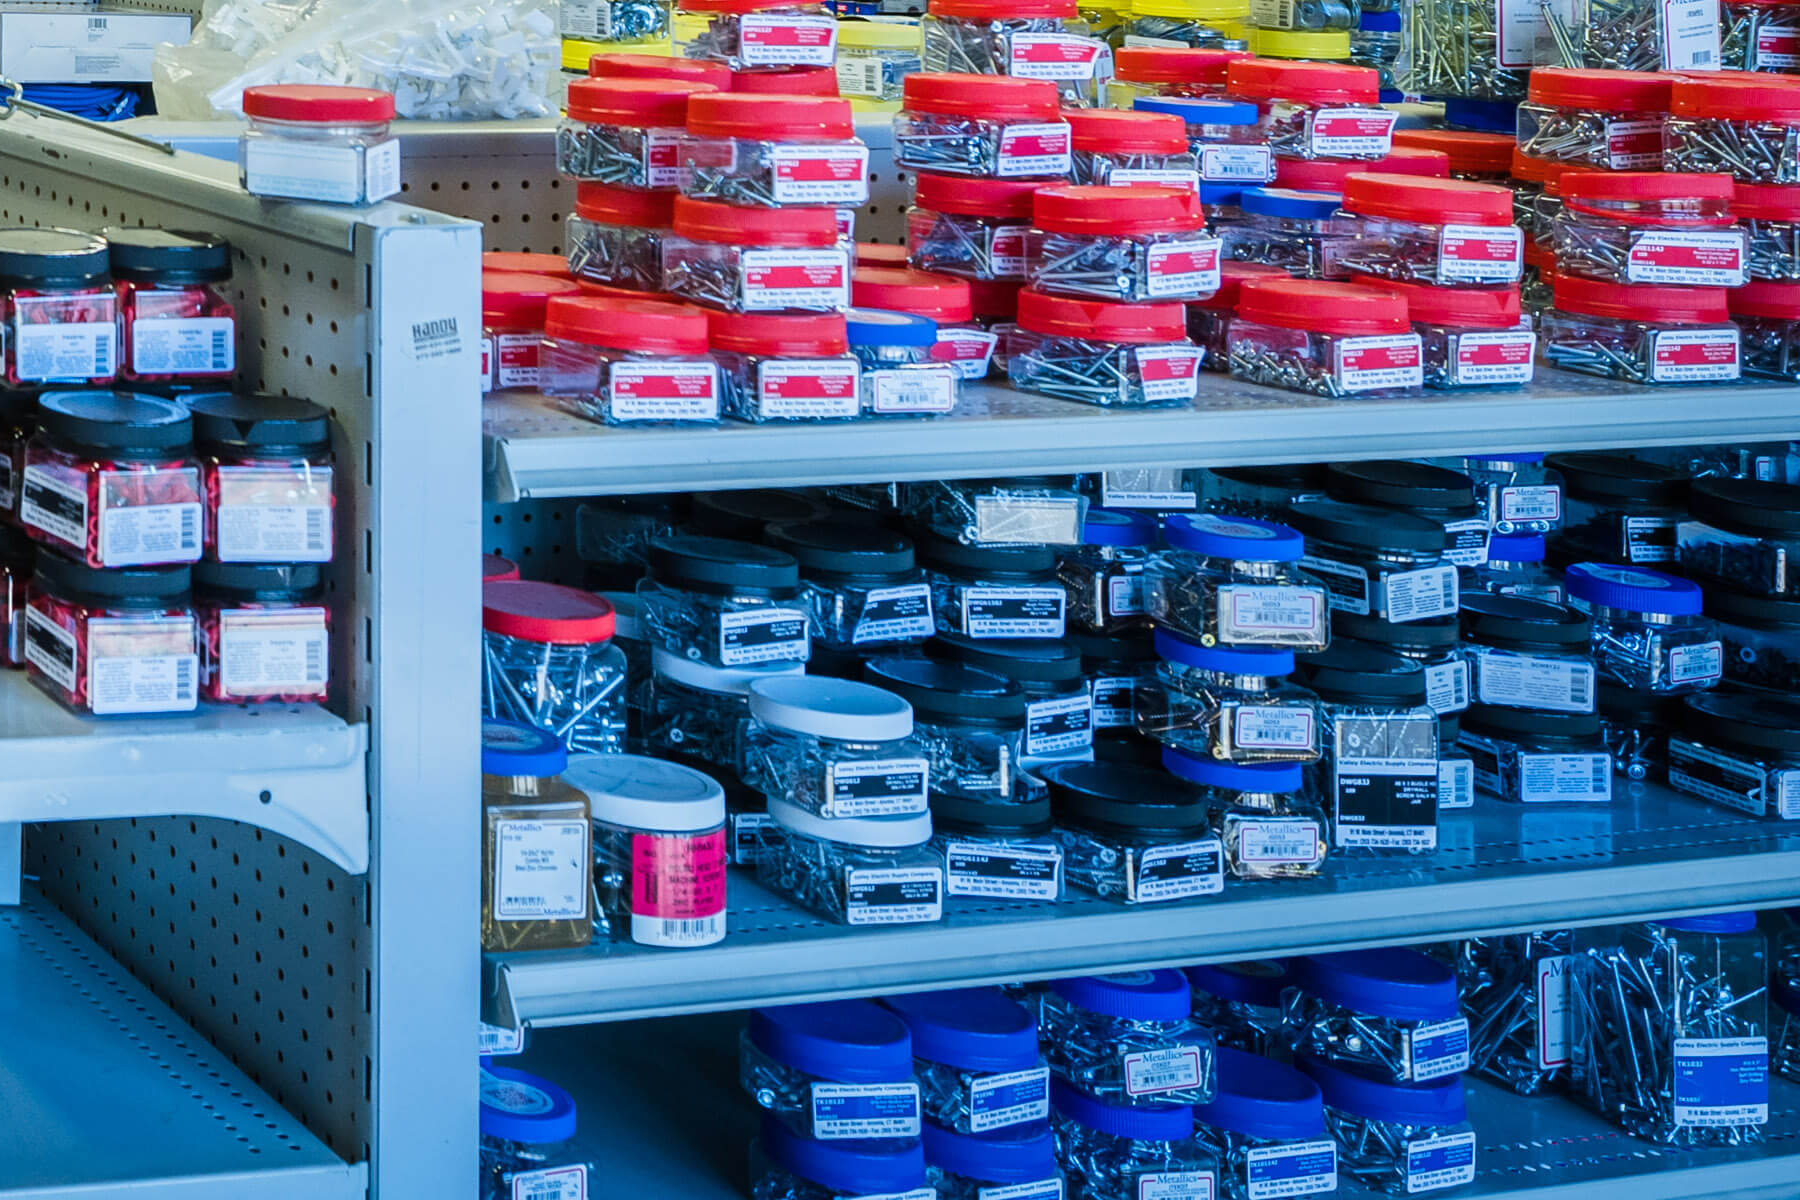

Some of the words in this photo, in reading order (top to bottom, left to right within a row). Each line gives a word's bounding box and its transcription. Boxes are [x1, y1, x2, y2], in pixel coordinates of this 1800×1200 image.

[1514, 486, 1549, 499] Metallics
[1251, 591, 1298, 601] Metallics
[1255, 709, 1296, 720] Metallics
[508, 823, 543, 832] Metallics
[1258, 823, 1302, 838] Metallics
[1142, 1050, 1184, 1064] Metallics
[1156, 1173, 1198, 1185] Metallics
